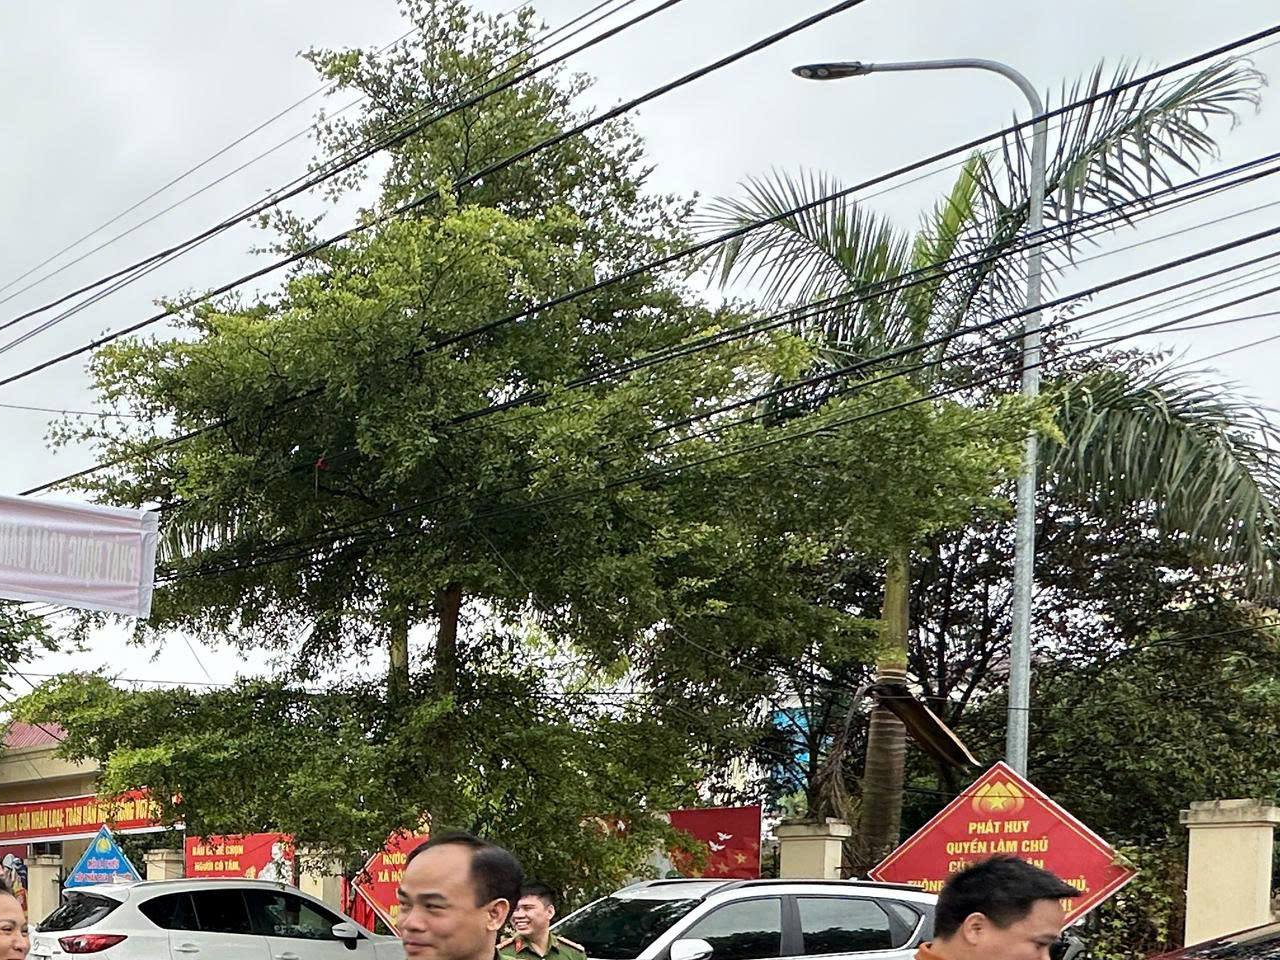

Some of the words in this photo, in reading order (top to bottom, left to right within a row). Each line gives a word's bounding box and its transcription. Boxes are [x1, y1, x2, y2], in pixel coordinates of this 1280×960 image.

[968, 819, 1001, 834] PHÁT
[1003, 821, 1029, 833] HUY
[990, 839, 1018, 853] LÀM
[1021, 836, 1049, 852] CHỦ
